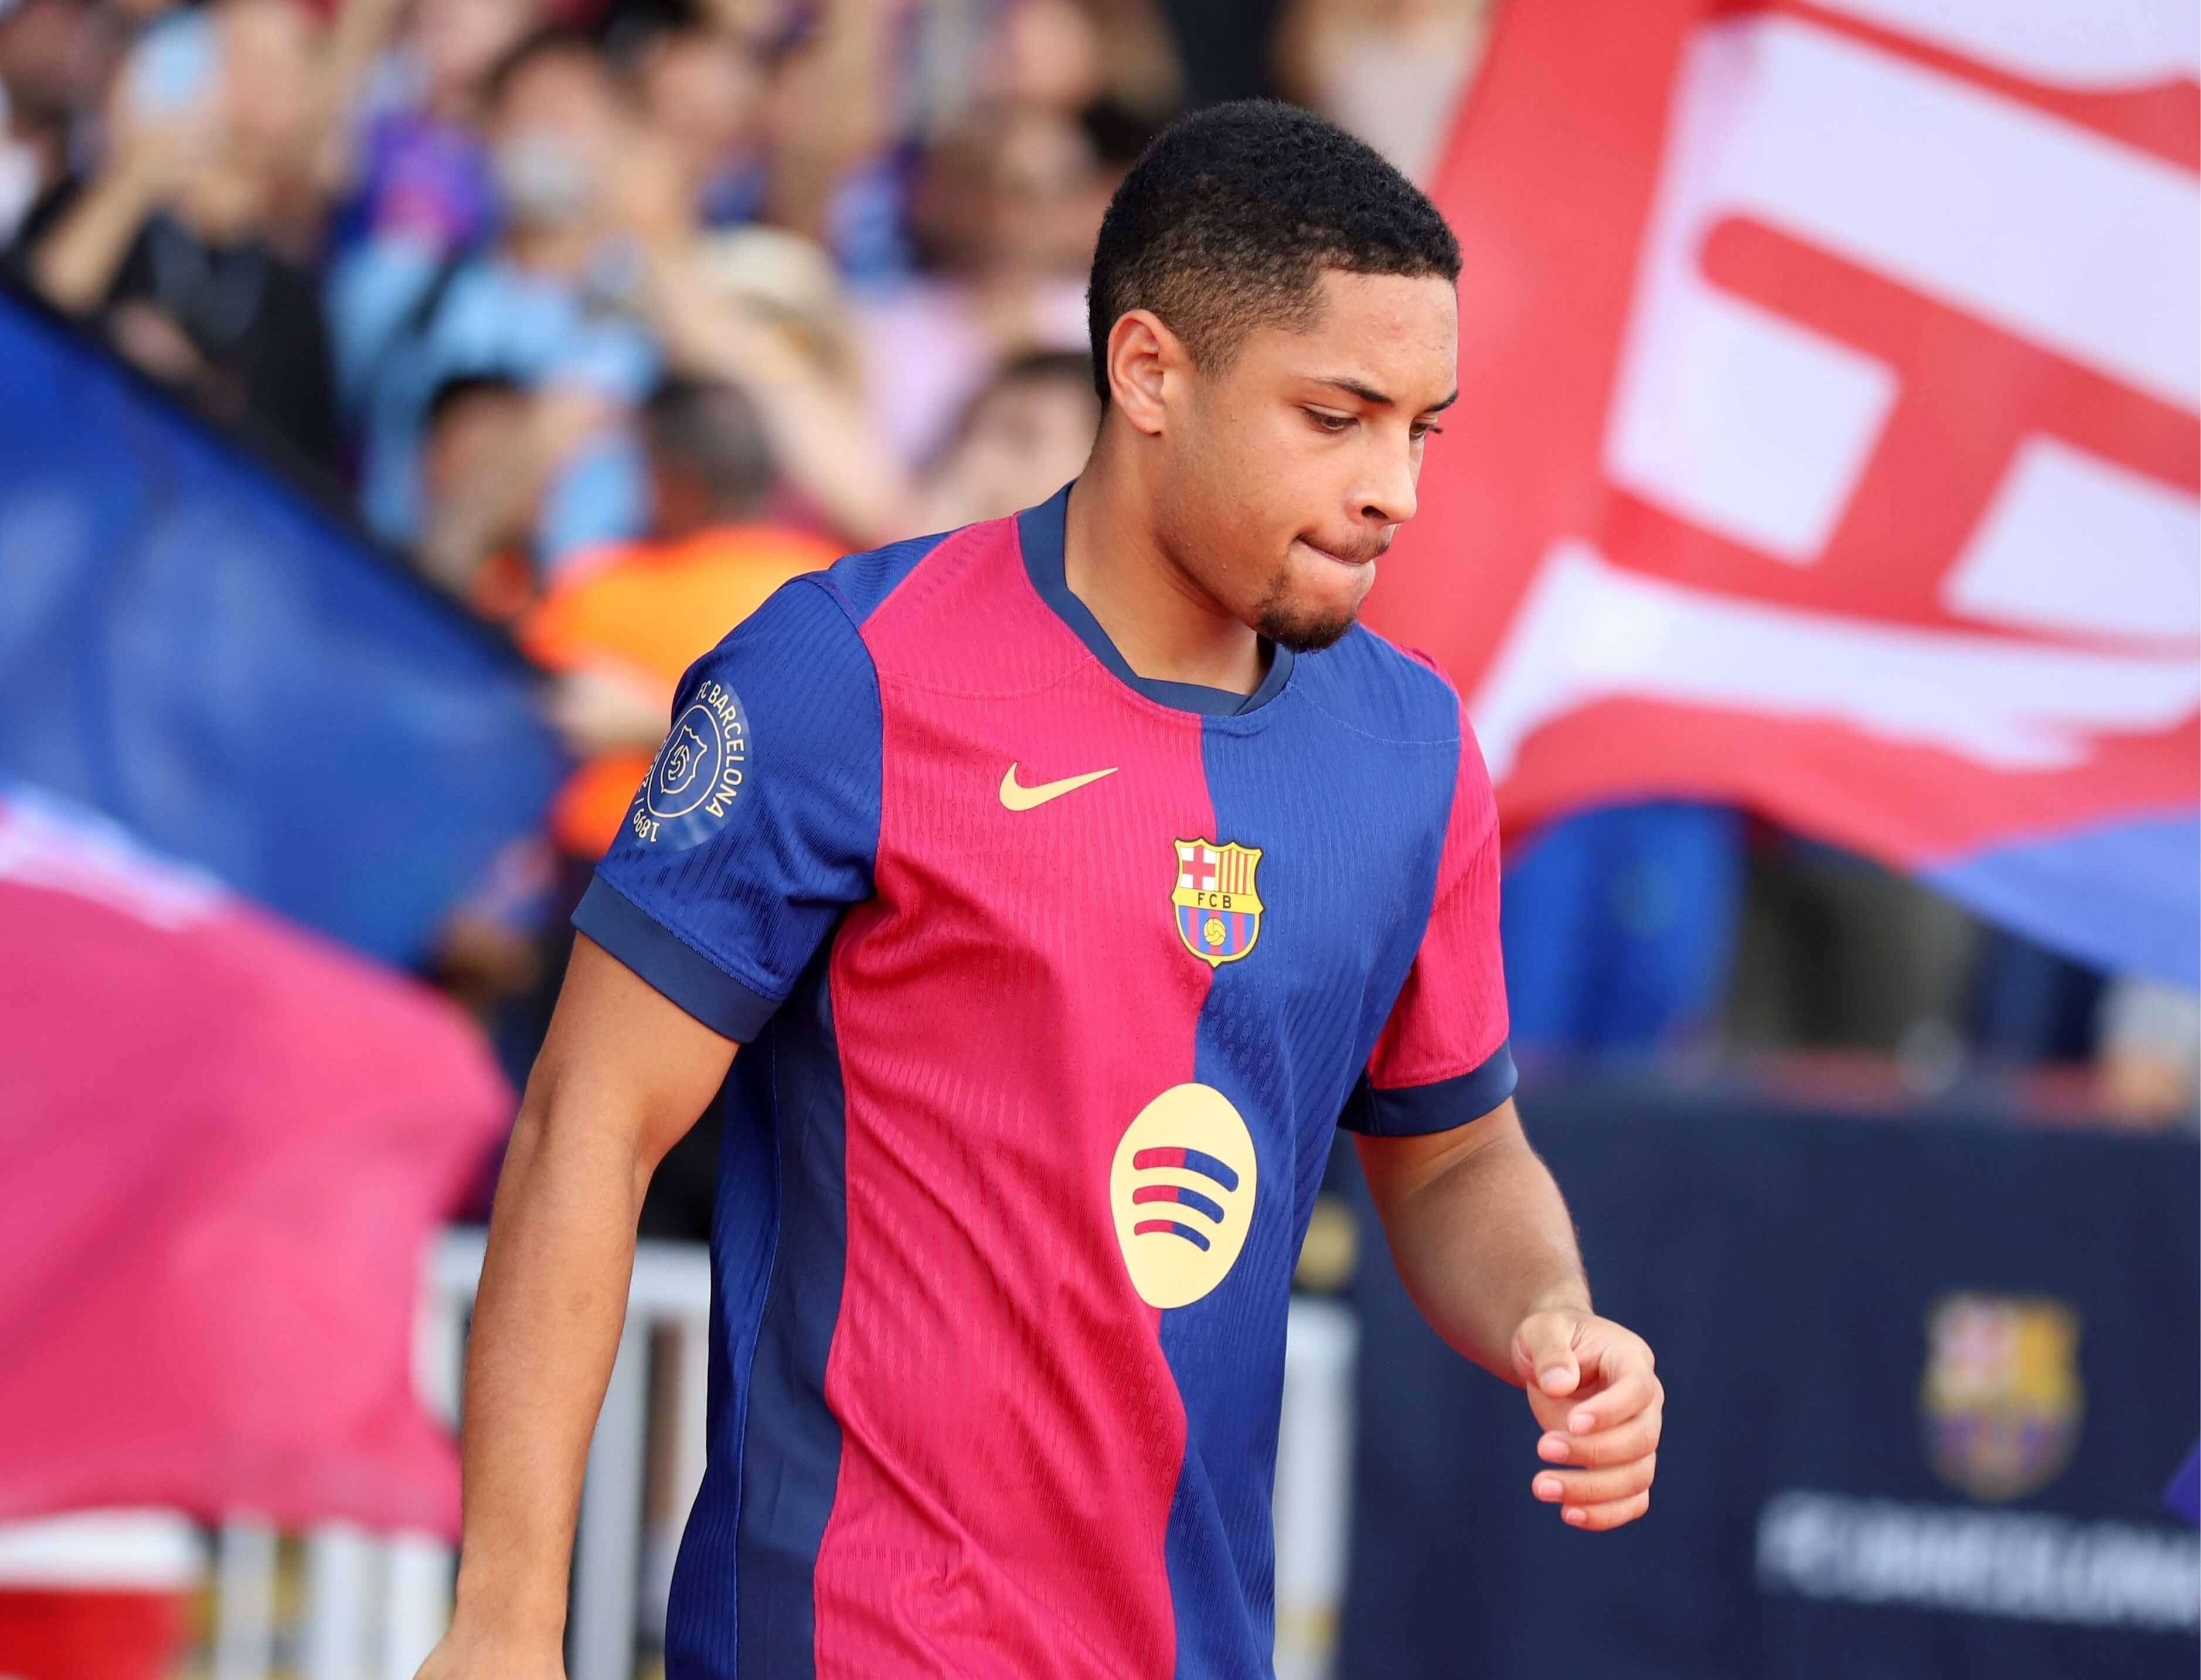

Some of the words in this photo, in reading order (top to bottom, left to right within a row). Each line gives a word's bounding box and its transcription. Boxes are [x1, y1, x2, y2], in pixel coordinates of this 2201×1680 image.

[696, 680, 711, 701] FC
[705, 683, 744, 818] BARCELONA
[633, 808, 660, 842] 1899
[1198, 892, 1232, 909] FCB
